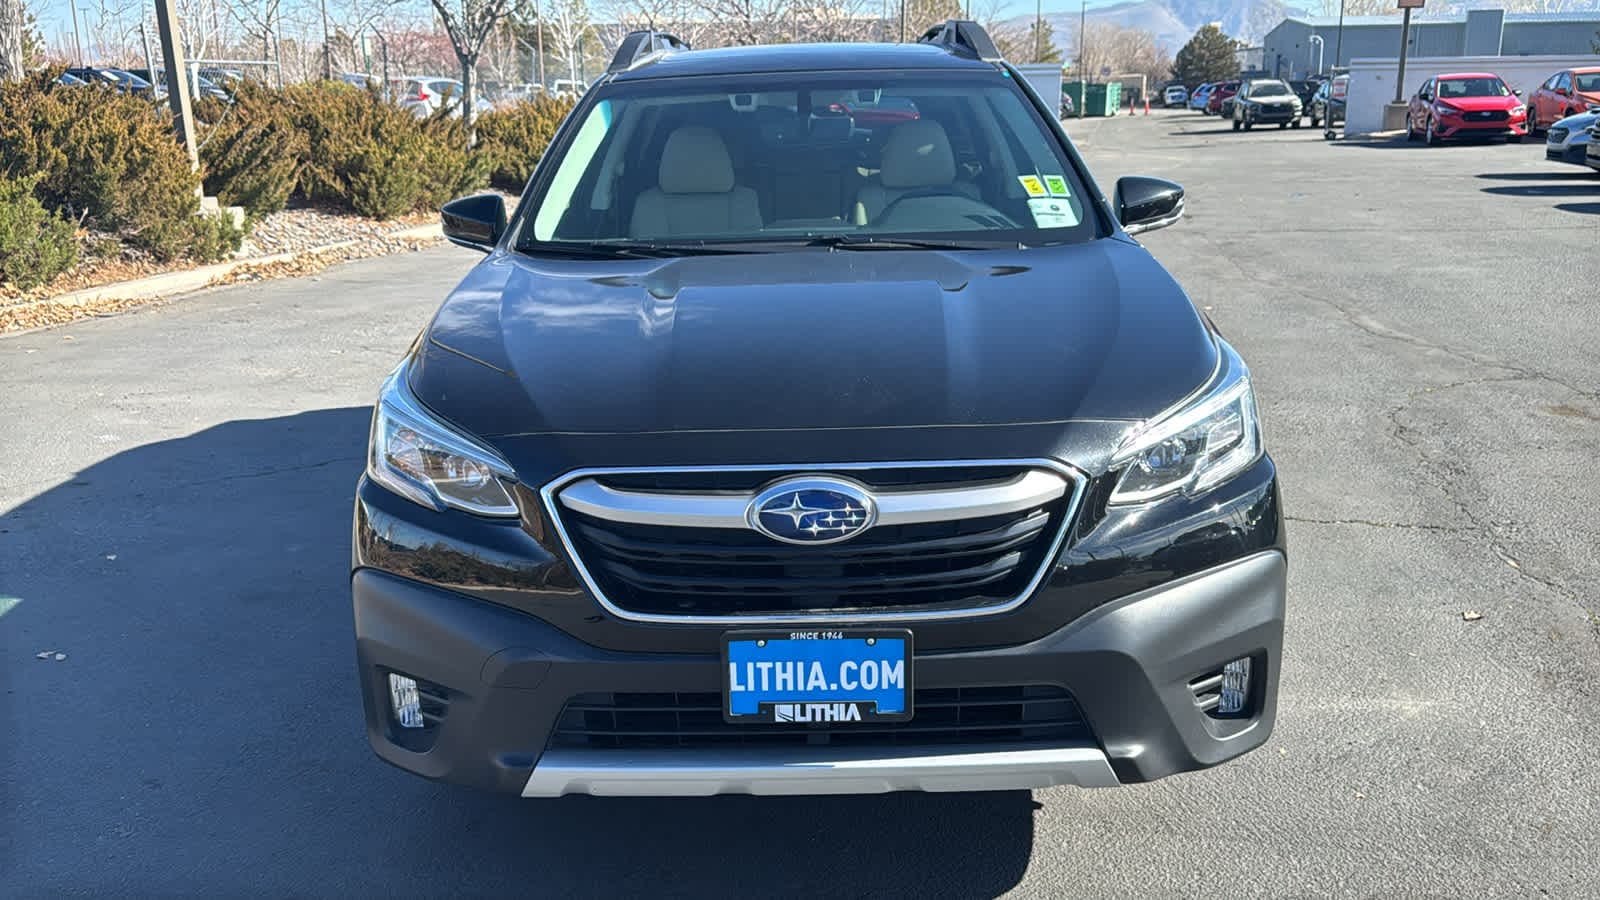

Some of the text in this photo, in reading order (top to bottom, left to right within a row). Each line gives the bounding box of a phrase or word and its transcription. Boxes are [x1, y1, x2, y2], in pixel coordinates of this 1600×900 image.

[790, 632, 819, 640] SINCE
[729, 660, 904, 691] LITHIA.COM
[794, 703, 862, 722] LITHIA
